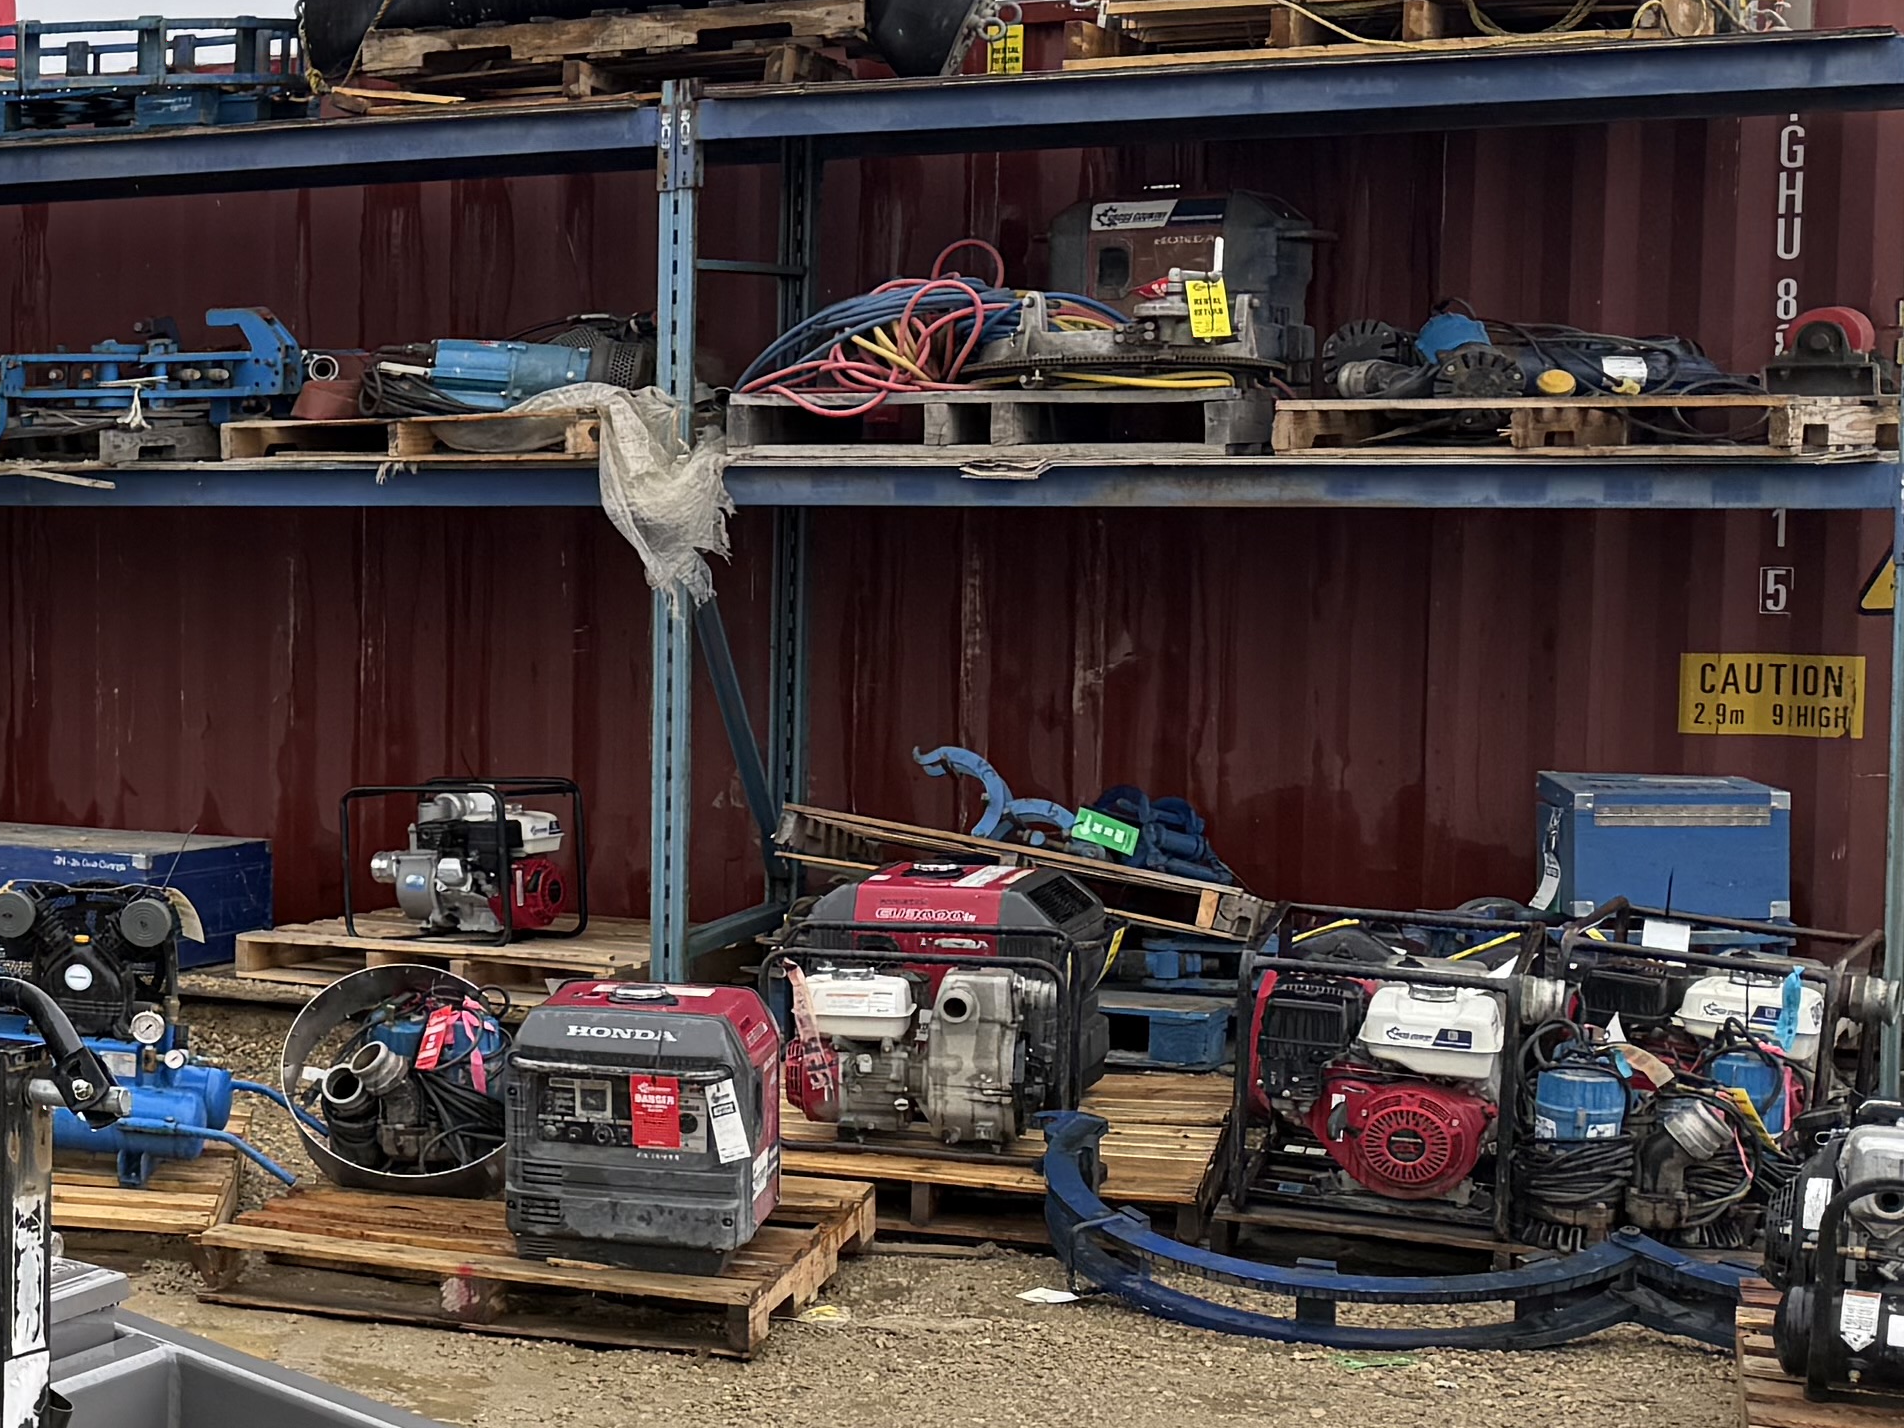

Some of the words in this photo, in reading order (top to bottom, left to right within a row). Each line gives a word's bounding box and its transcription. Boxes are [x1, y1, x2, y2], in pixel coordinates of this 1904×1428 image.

[1765, 569, 1788, 612] 5
[1699, 662, 1844, 698] CAUTION
[566, 1024, 678, 1042] HONDA
